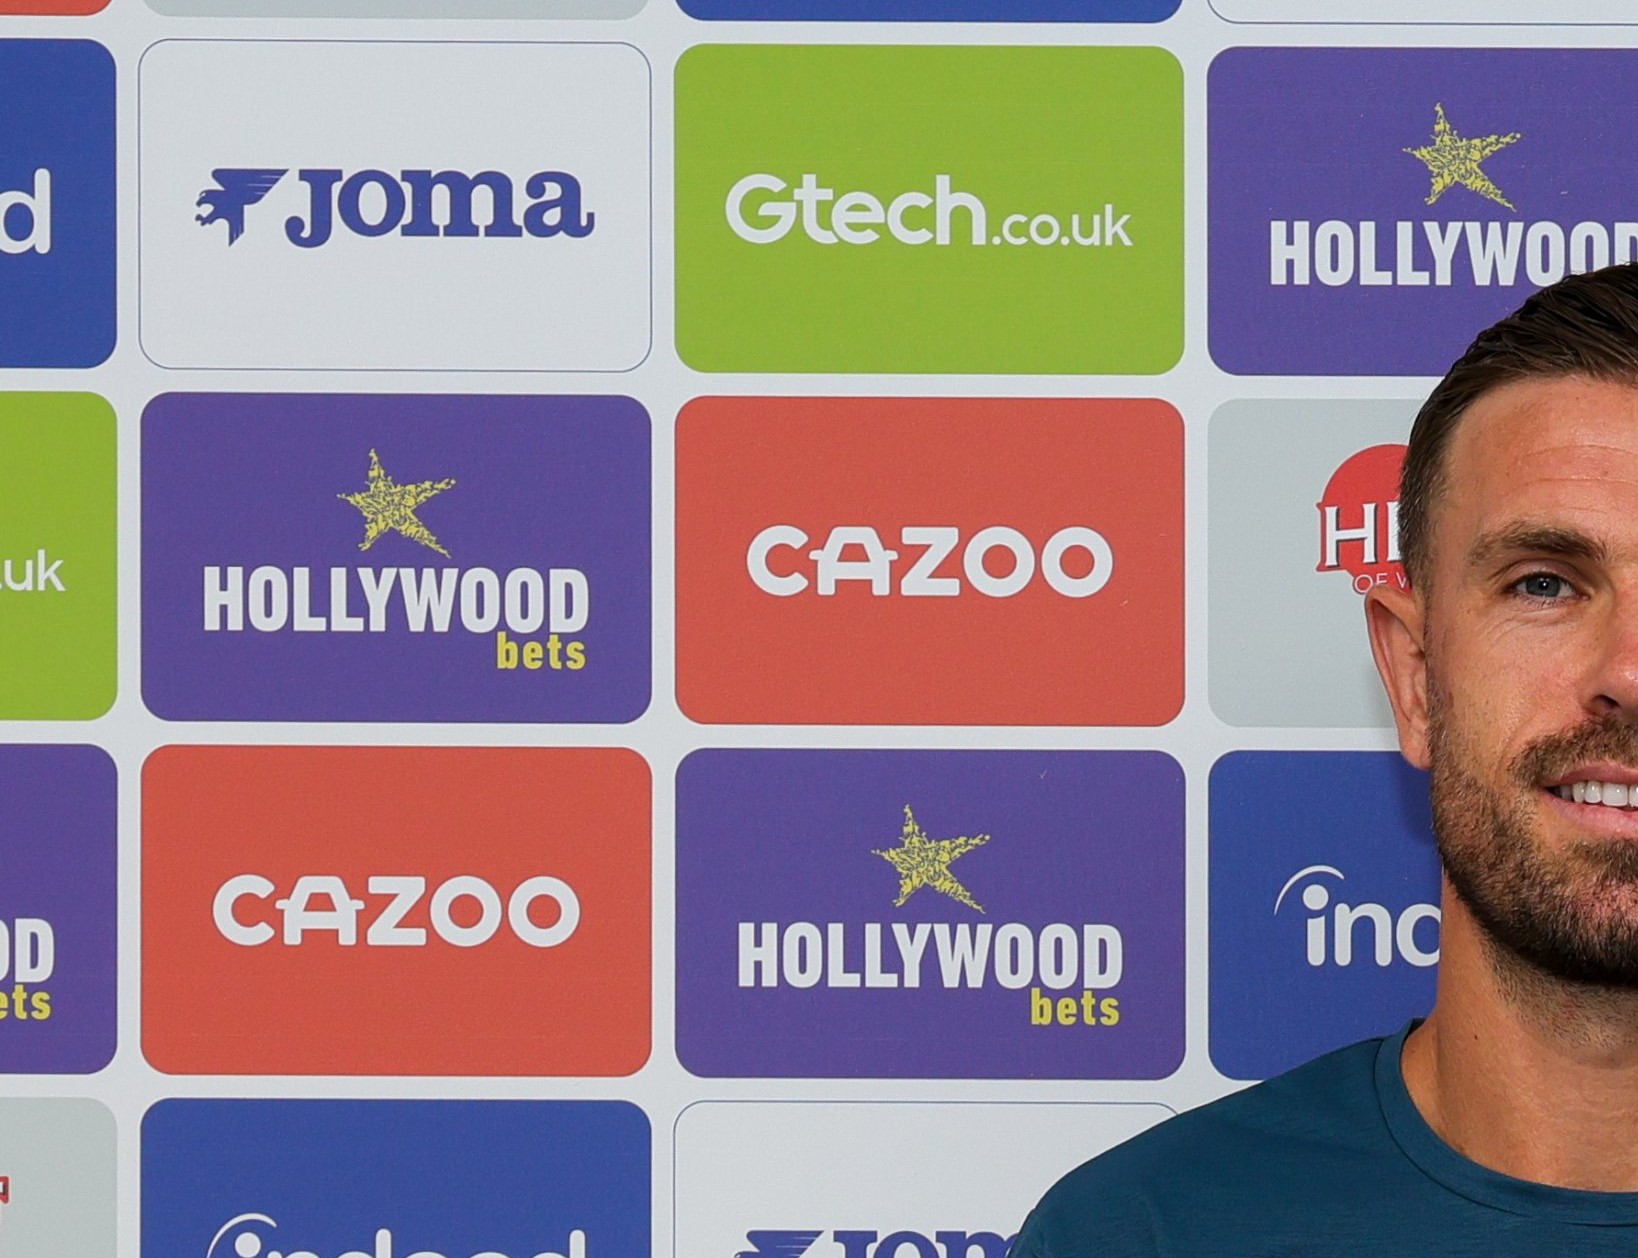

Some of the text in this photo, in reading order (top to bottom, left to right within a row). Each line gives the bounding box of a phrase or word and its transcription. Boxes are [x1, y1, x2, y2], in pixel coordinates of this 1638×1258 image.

[725, 173, 1133, 247] Gtech.co.uk
[746, 525, 1114, 598] CAZOO
[204, 565, 589, 634] HOLLYWOOD
[496, 633, 586, 670] bets
[212, 874, 581, 948] CAZOO
[738, 921, 1123, 989] HOLLYWOOD
[1030, 988, 1120, 1026] bets
